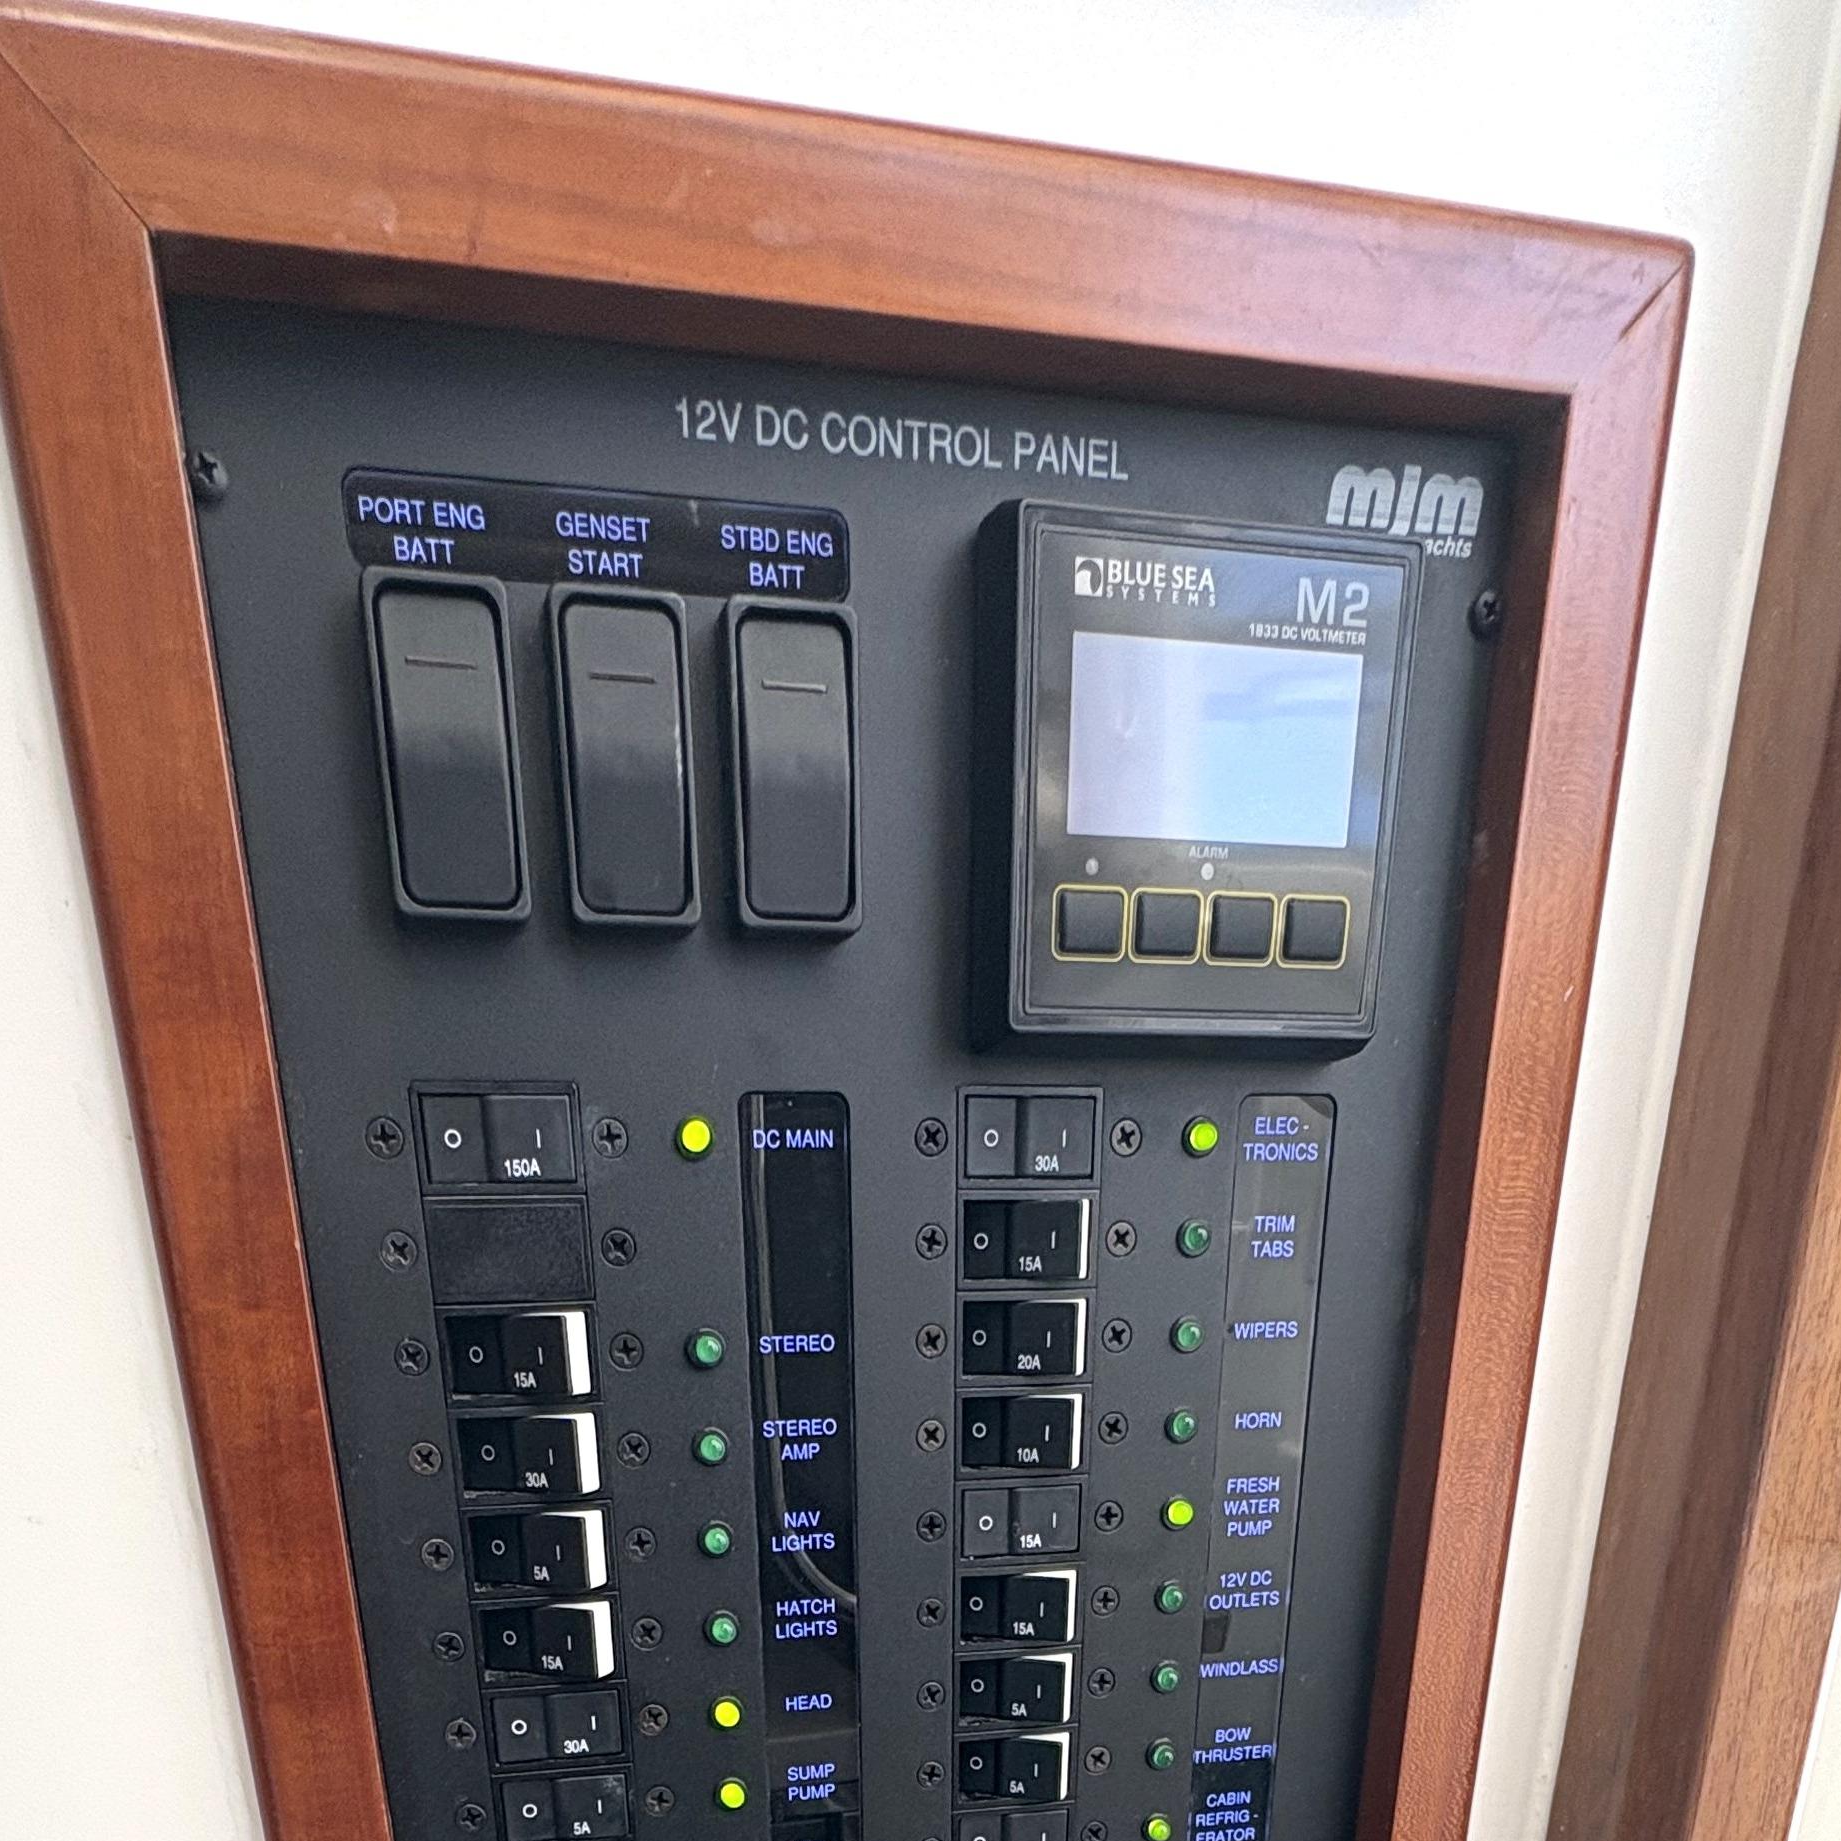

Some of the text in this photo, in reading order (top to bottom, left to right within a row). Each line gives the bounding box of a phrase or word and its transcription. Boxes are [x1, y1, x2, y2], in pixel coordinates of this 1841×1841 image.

[675, 397, 1128, 481] 12V DC CONTROL PANEL
[1325, 464, 1484, 537] mjm
[358, 495, 485, 531] PORT ENG
[555, 511, 650, 543] GENSET
[720, 524, 833, 557] STBD ENG
[1424, 537, 1472, 559] achts
[393, 536, 454, 565] BATT
[568, 548, 643, 579] START
[749, 562, 805, 590] BATT
[1107, 560, 1215, 592] BLUE SEA
[1106, 585, 1216, 608] SYSTEMS
[1281, 626, 1298, 641] DC
[1300, 627, 1366, 646] VOLTMETER
[1189, 846, 1229, 860] ALARM
[1254, 1116, 1299, 1135] ELEC
[753, 1129, 833, 1149] DC MAIN
[1243, 1142, 1319, 1162] TRONICS
[504, 1159, 541, 1178] 150A
[1035, 1156, 1059, 1172] 30A
[1254, 1216, 1295, 1233] TRIM
[1251, 1241, 1294, 1258] TABS
[1018, 1257, 1042, 1272] 15A
[1234, 1321, 1299, 1339] WIPERS
[759, 1334, 835, 1355] STEREO
[1018, 1355, 1041, 1370] 20A
[513, 1372, 537, 1389] 15A
[763, 1418, 837, 1437] STEREO
[1235, 1412, 1282, 1429] HORN
[781, 1443, 820, 1461] AMP
[1017, 1448, 1039, 1463] 10A
[525, 1472, 548, 1488] 30A
[1226, 1477, 1280, 1494] FRESH
[1224, 1498, 1280, 1516] WATER
[784, 1511, 820, 1528] NAV
[1227, 1520, 1272, 1537] PUMP
[772, 1533, 835, 1553] LIGHTS
[1020, 1534, 1042, 1549] 15A
[534, 1566, 550, 1581] 5A
[1220, 1570, 1272, 1589] 12V DC
[776, 1599, 835, 1616] HATCH
[1209, 1591, 1279, 1611] OUTLETS
[775, 1620, 838, 1639] LIGHTS
[1013, 1622, 1035, 1637] 15A
[541, 1655, 563, 1671] 15A
[1199, 1658, 1279, 1679] WINDLASS
[785, 1694, 832, 1712] HEAD
[1011, 1703, 1027, 1717] 5A
[1214, 1727, 1251, 1743] BOW
[564, 1740, 589, 1754] 30A
[1193, 1745, 1272, 1765] THRUSTER
[787, 1764, 835, 1781] SUMP
[788, 1784, 835, 1801] PUMP
[1009, 1781, 1025, 1794] 5A
[1206, 1791, 1251, 1808] CABIN
[1195, 1810, 1250, 1827] REFRIG
[573, 1821, 591, 1835] 5A
